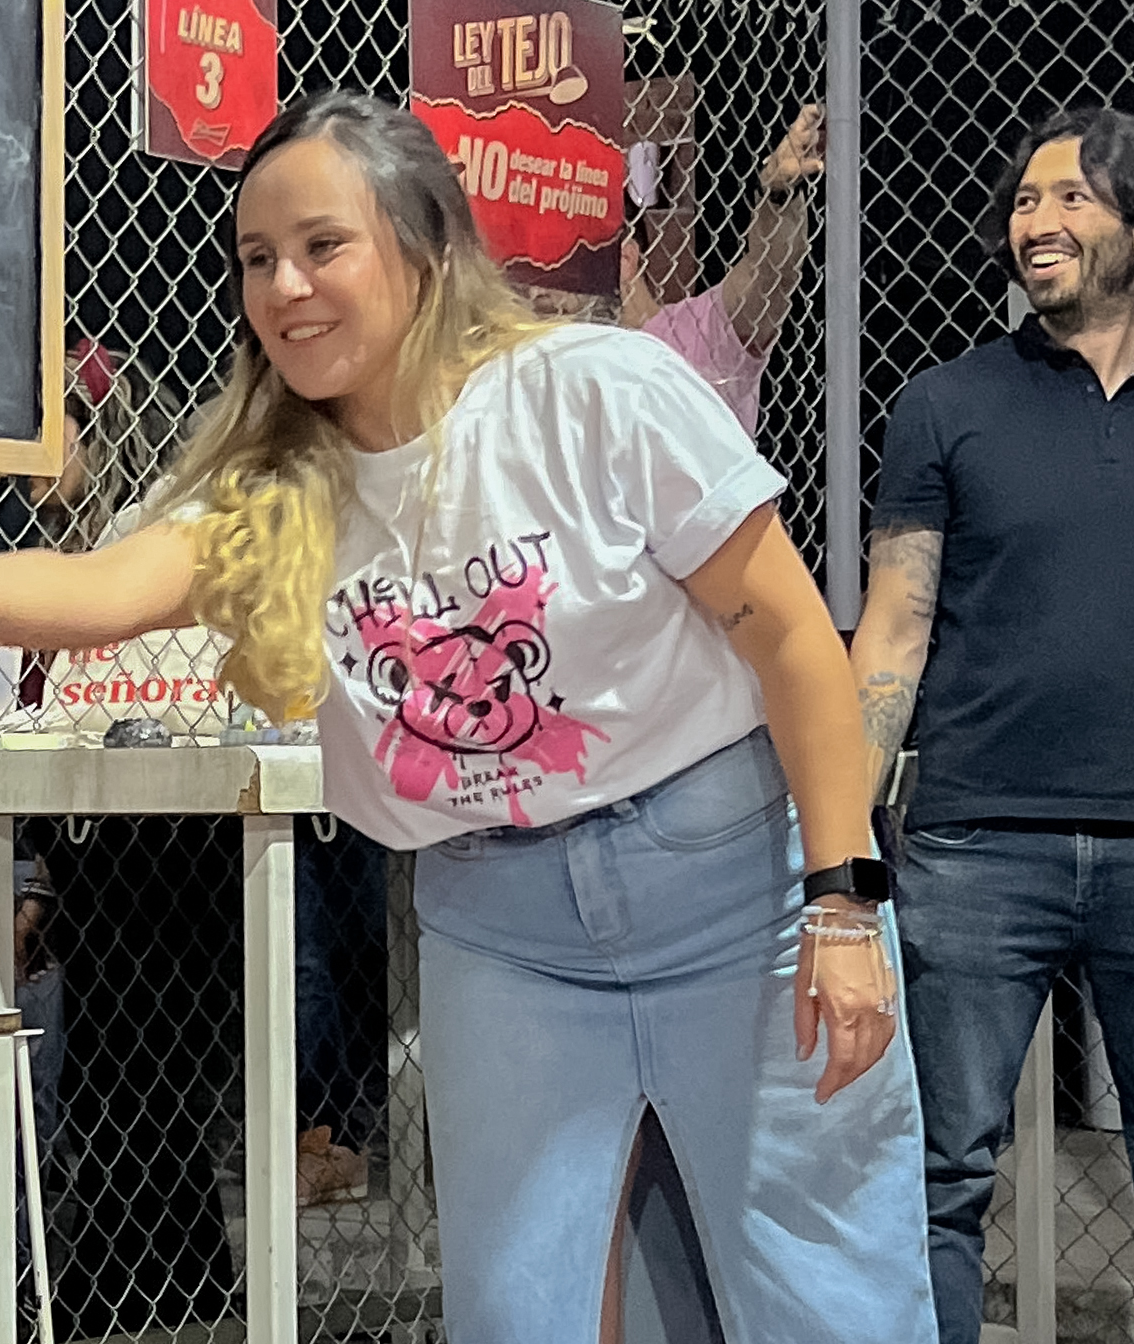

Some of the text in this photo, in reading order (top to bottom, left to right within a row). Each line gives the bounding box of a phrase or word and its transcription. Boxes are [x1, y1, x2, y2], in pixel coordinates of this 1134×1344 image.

[177, 4, 243, 56] LÍNEA
[453, 10, 574, 92] LEY TEJO
[195, 51, 225, 110] 3
[467, 64, 495, 98] DEL
[458, 134, 508, 201] NO
[509, 148, 609, 187] desear la línea
[508, 174, 609, 220] del prójimo
[465, 530, 551, 599] OUT
[61, 669, 219, 707] señora
